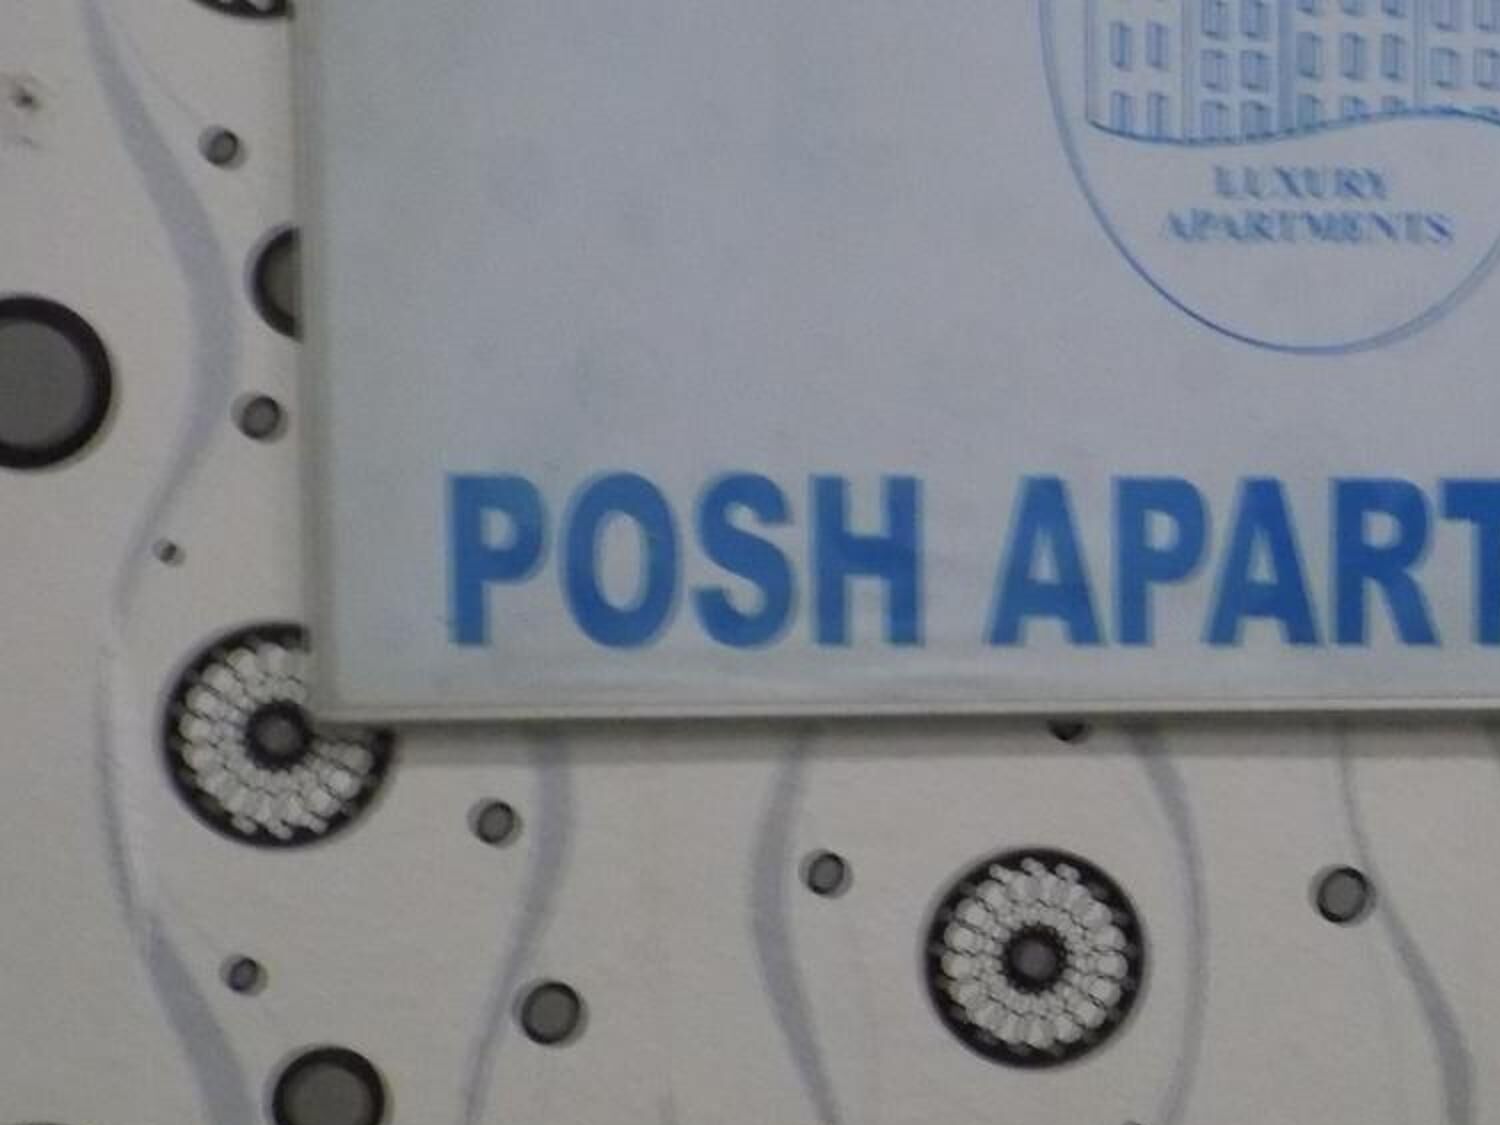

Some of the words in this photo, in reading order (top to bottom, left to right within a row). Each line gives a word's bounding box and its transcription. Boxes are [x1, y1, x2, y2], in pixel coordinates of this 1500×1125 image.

[1211, 165, 1389, 200] LUXURY
[1163, 209, 1455, 245] APARTMENTS
[446, 471, 926, 650] POSH
